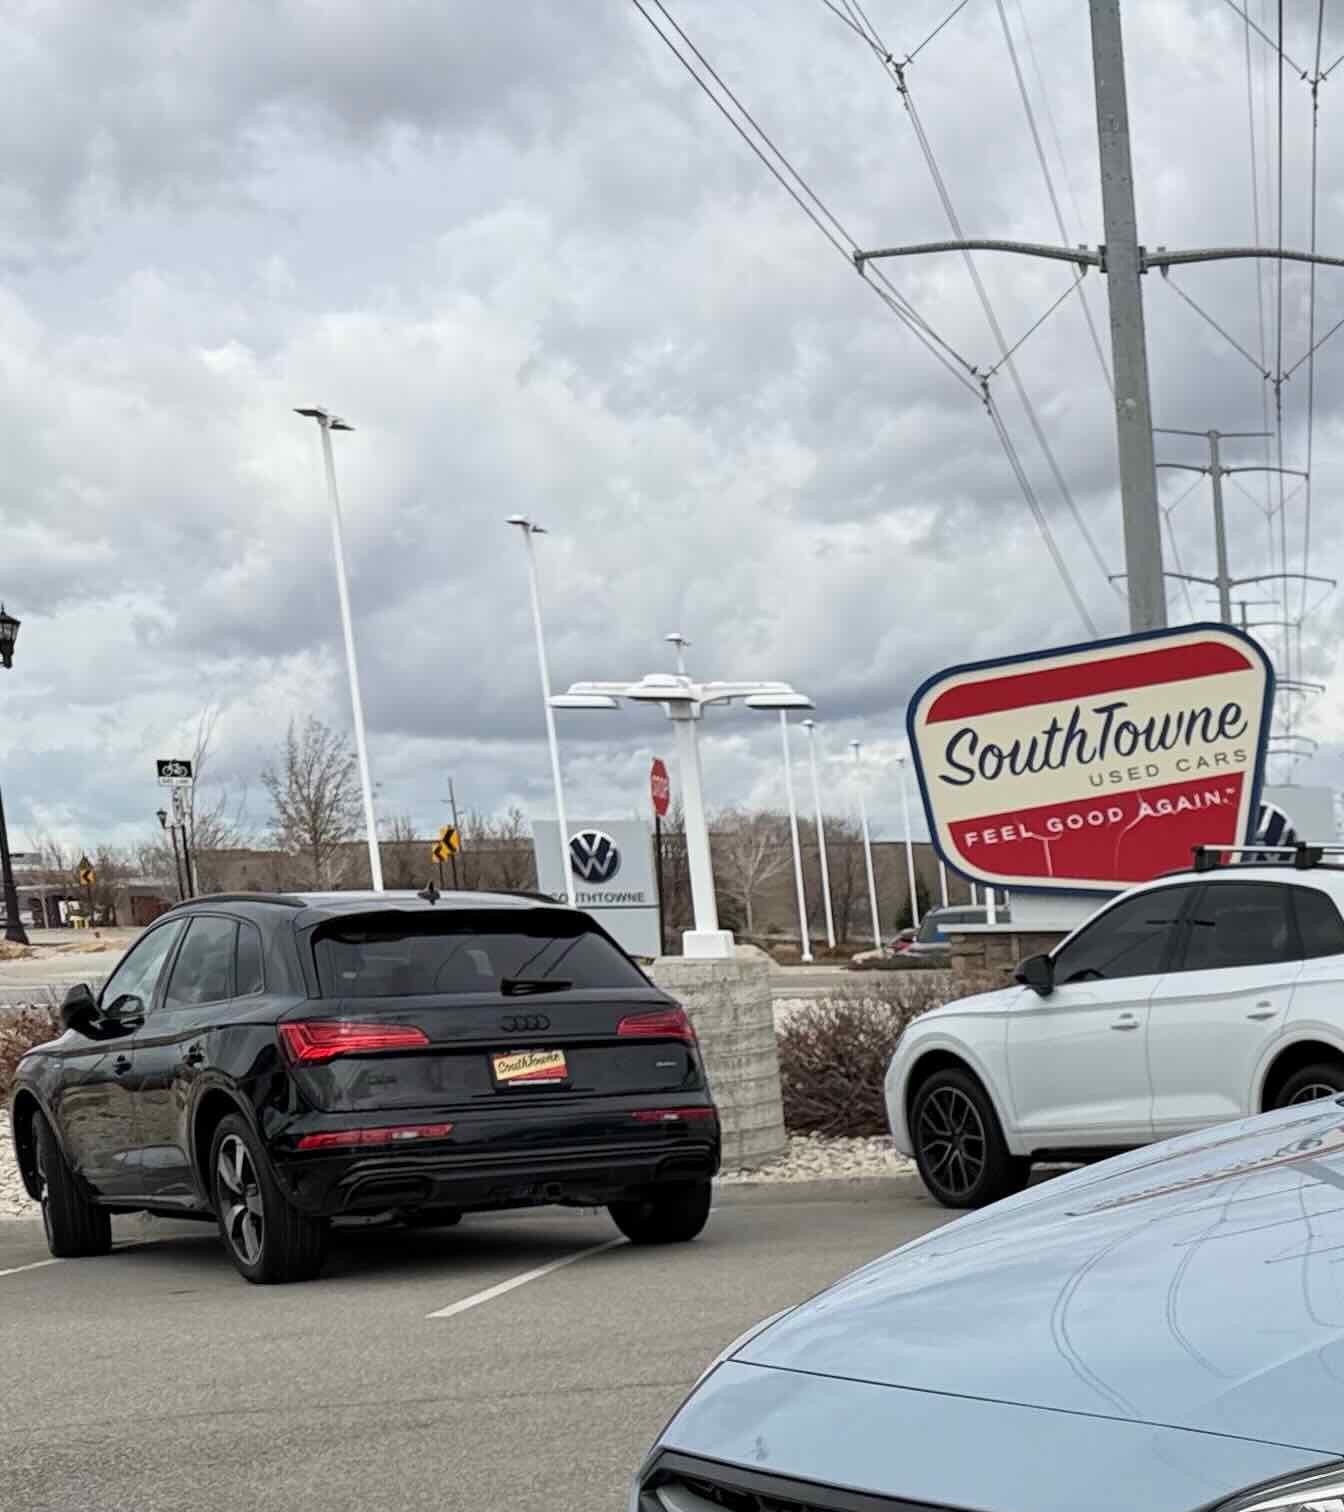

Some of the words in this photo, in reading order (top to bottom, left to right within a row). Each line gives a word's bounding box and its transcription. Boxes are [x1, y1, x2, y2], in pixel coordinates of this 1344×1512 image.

[1089, 764, 1160, 787] USED
[1176, 749, 1248, 772] CARS
[964, 824, 1033, 848] FEEL
[1046, 807, 1124, 833] GOOD
